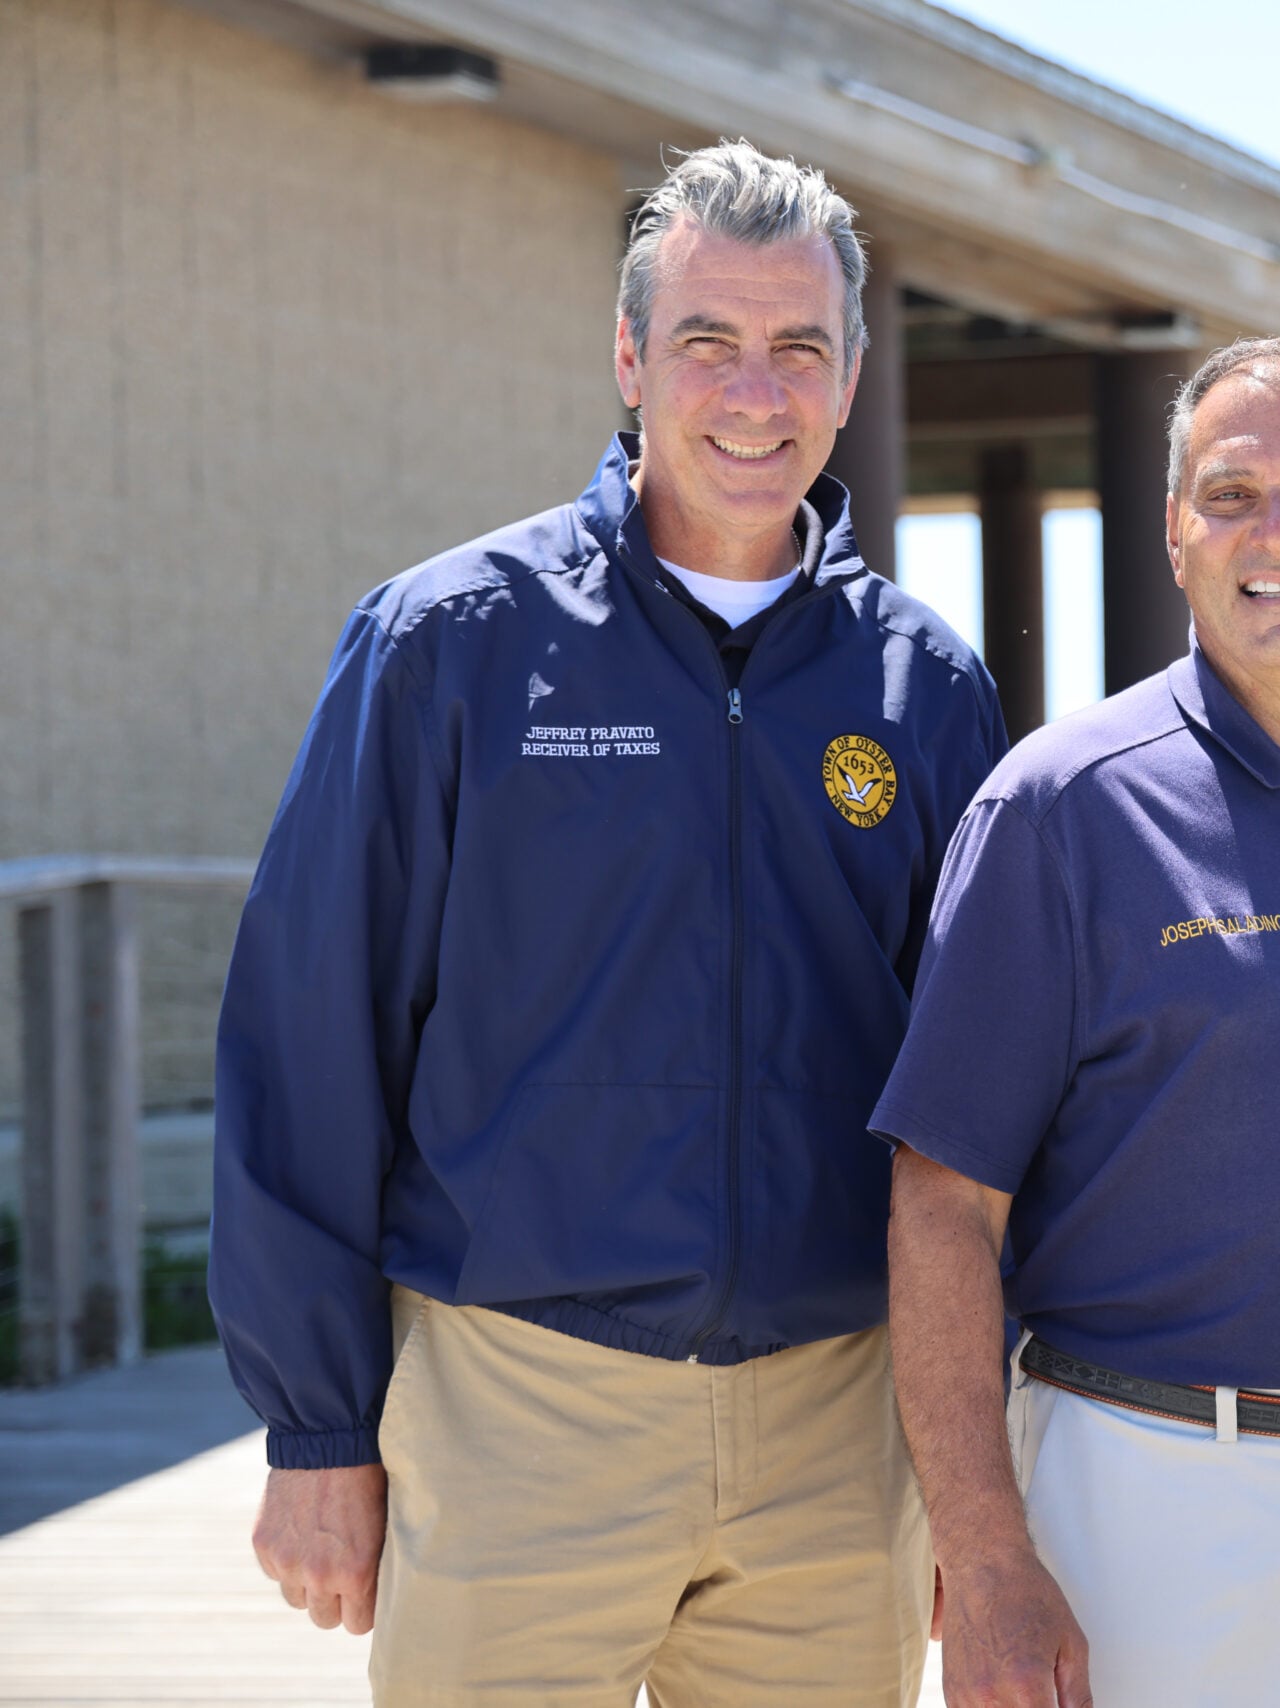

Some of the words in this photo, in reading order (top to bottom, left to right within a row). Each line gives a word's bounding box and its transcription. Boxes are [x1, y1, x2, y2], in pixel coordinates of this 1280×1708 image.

[525, 726, 587, 740] JEFFREY
[590, 726, 655, 740] PRAVATO
[521, 742, 591, 757] RECEIVER
[593, 743, 611, 756] OF
[613, 742, 661, 756] TAXES
[823, 745, 837, 784] TOWN
[837, 736, 850, 750] OF
[856, 737, 892, 774] OYSTER
[883, 780, 895, 807] BAY
[843, 753, 875, 776] 1653
[831, 794, 853, 818] NEW
[856, 809, 882, 826] YORK
[1160, 917, 1218, 947] JOSEPH
